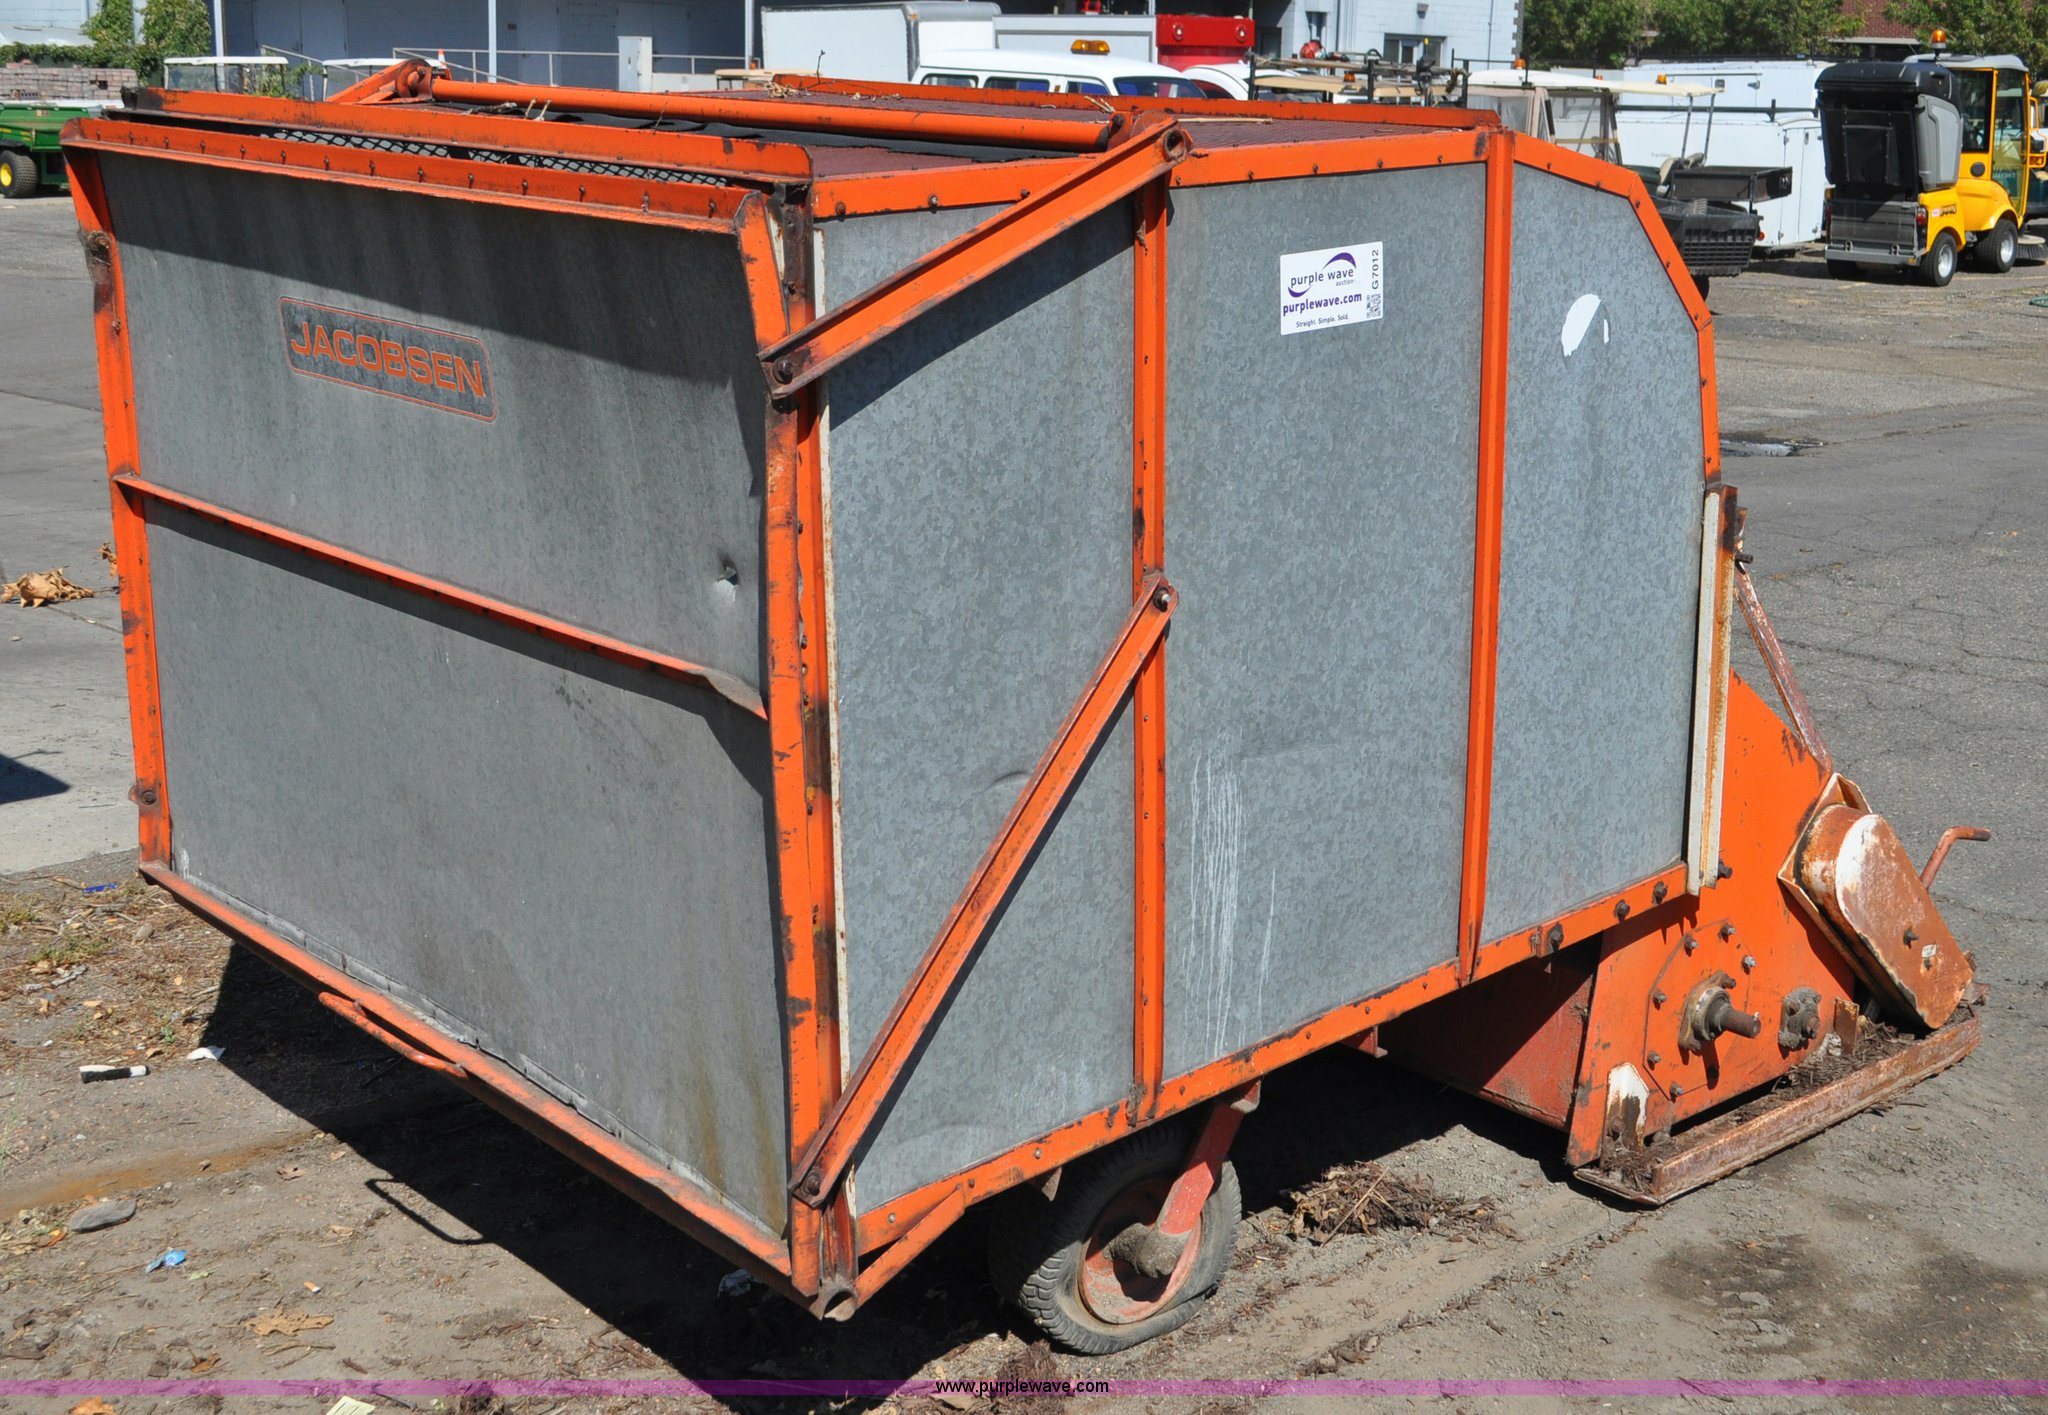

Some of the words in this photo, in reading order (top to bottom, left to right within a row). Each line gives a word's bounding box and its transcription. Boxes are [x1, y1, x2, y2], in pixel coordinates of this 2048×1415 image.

[1290, 271, 1324, 288] purple
[1327, 268, 1354, 280] wave
[1283, 293, 1362, 317] purplewave.com
[1296, 318, 1316, 328] Straight.
[1318, 316, 1336, 325] Simple.
[291, 321, 486, 397] JACOBSEN
